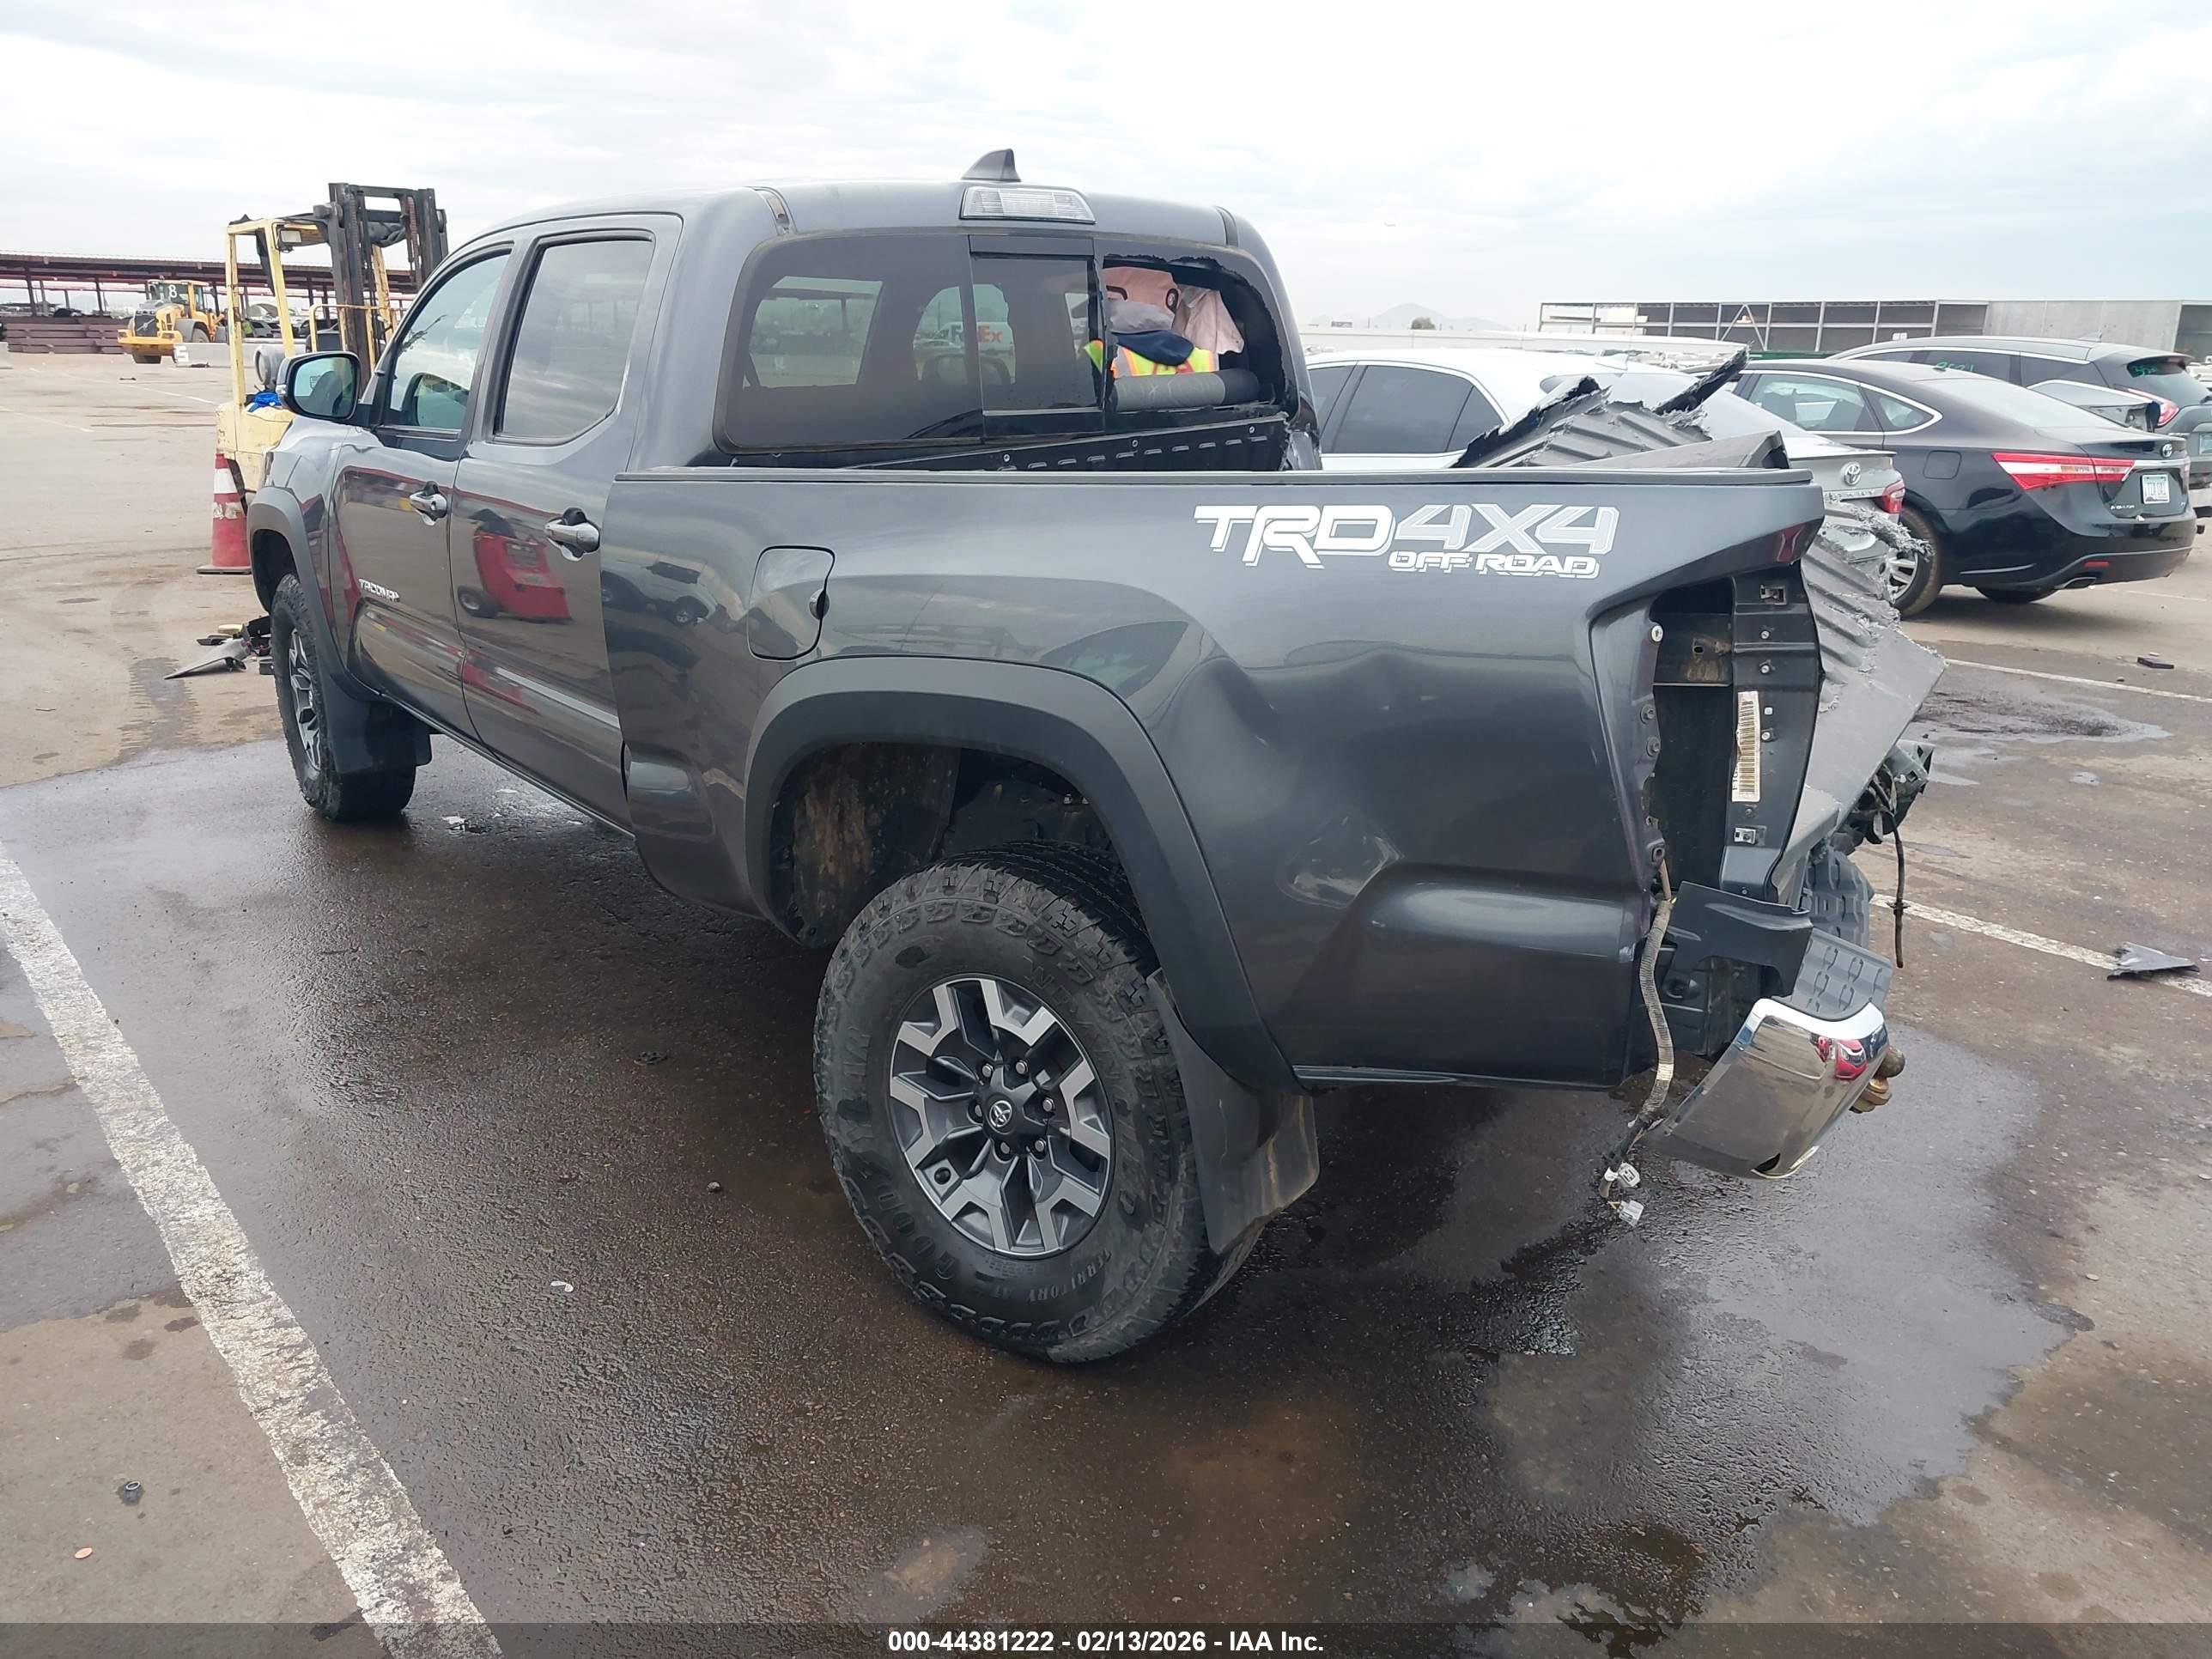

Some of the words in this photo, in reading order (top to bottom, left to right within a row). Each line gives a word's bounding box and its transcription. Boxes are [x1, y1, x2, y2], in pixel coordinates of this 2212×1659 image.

[168, 284, 178, 298] 8
[951, 325, 1003, 343] FeEx
[1193, 503, 1396, 569] TRD
[1394, 503, 1620, 556] 4X4
[1388, 551, 1473, 574] OFF
[1474, 553, 1600, 580] ROAD
[358, 578, 400, 602] TACOMA
